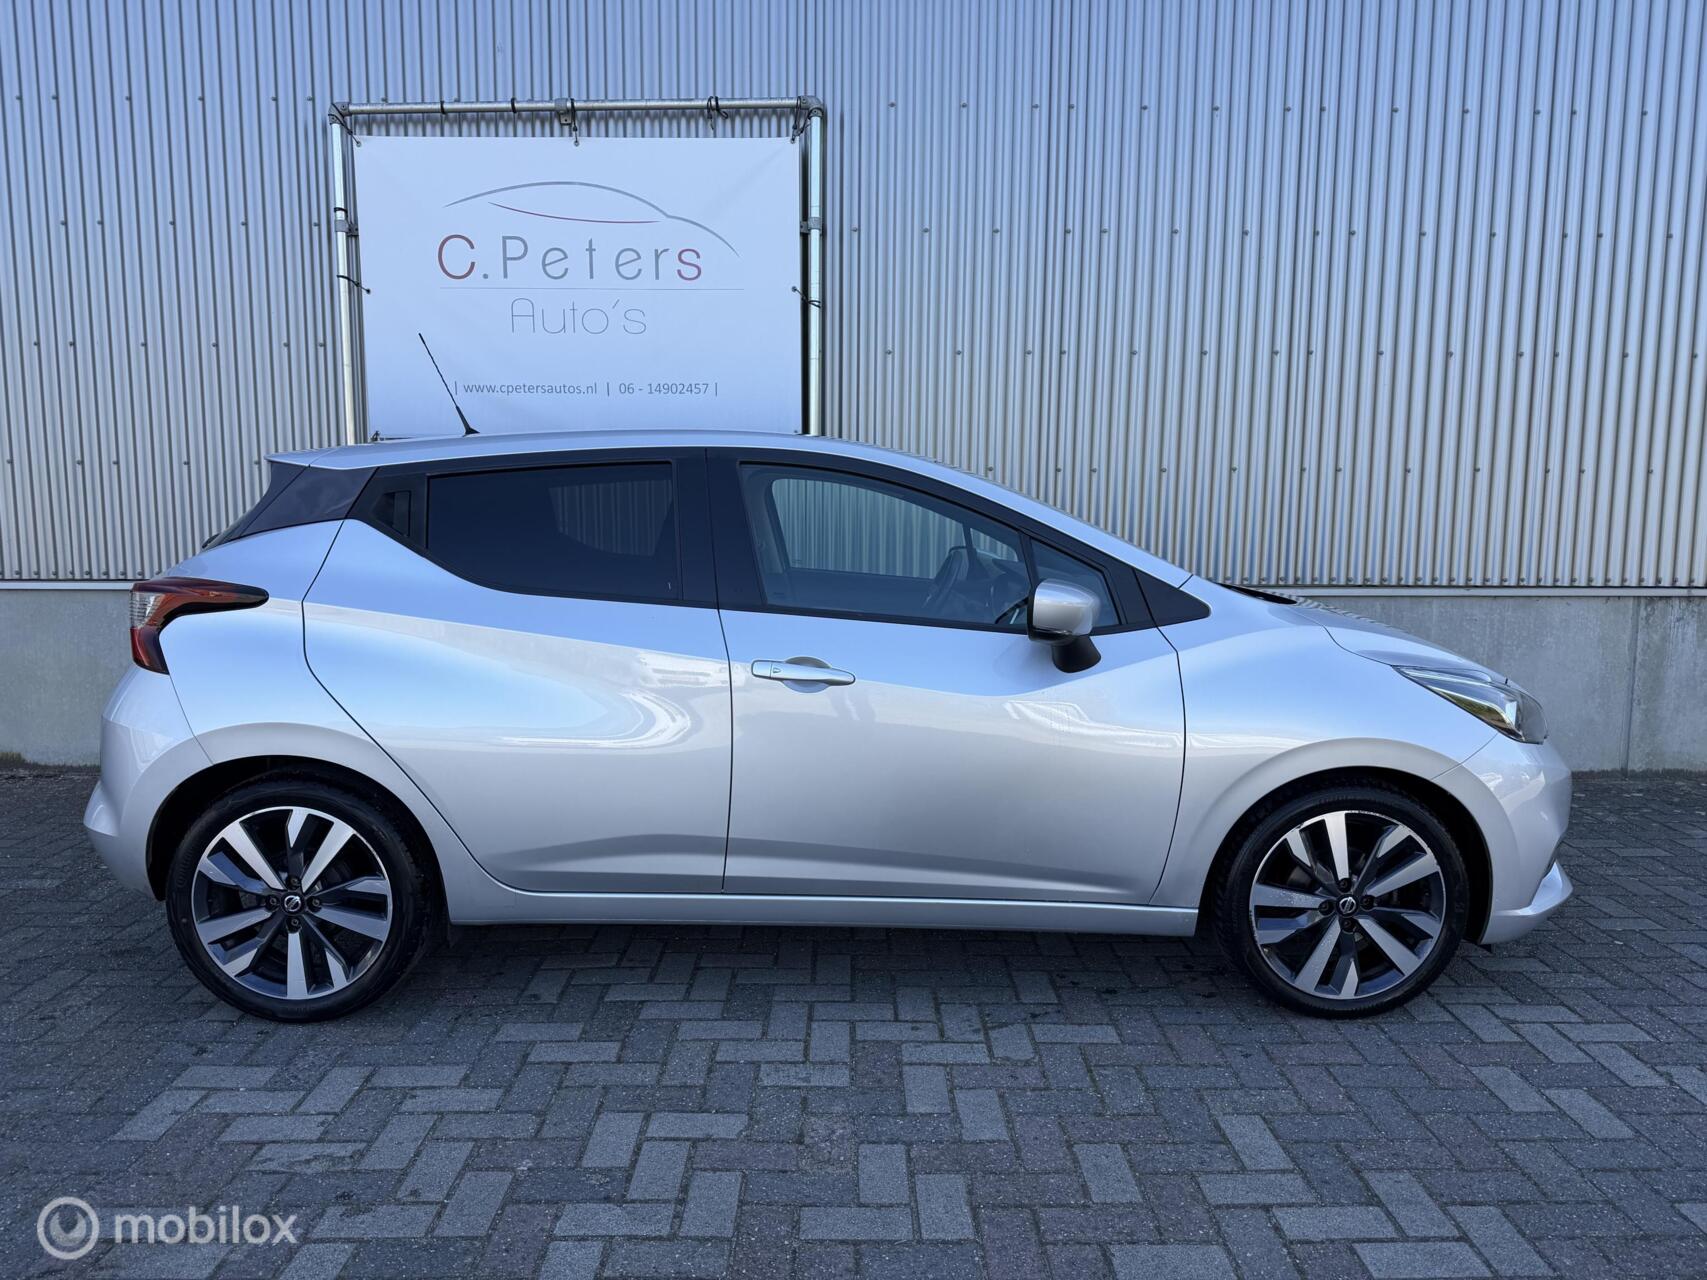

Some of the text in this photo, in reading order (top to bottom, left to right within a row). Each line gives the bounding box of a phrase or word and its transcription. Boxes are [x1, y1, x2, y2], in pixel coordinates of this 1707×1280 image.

[463, 381, 598, 396] www.cpetersautos.nl
[618, 382, 636, 395] 06
[647, 382, 710, 395] 14902457
